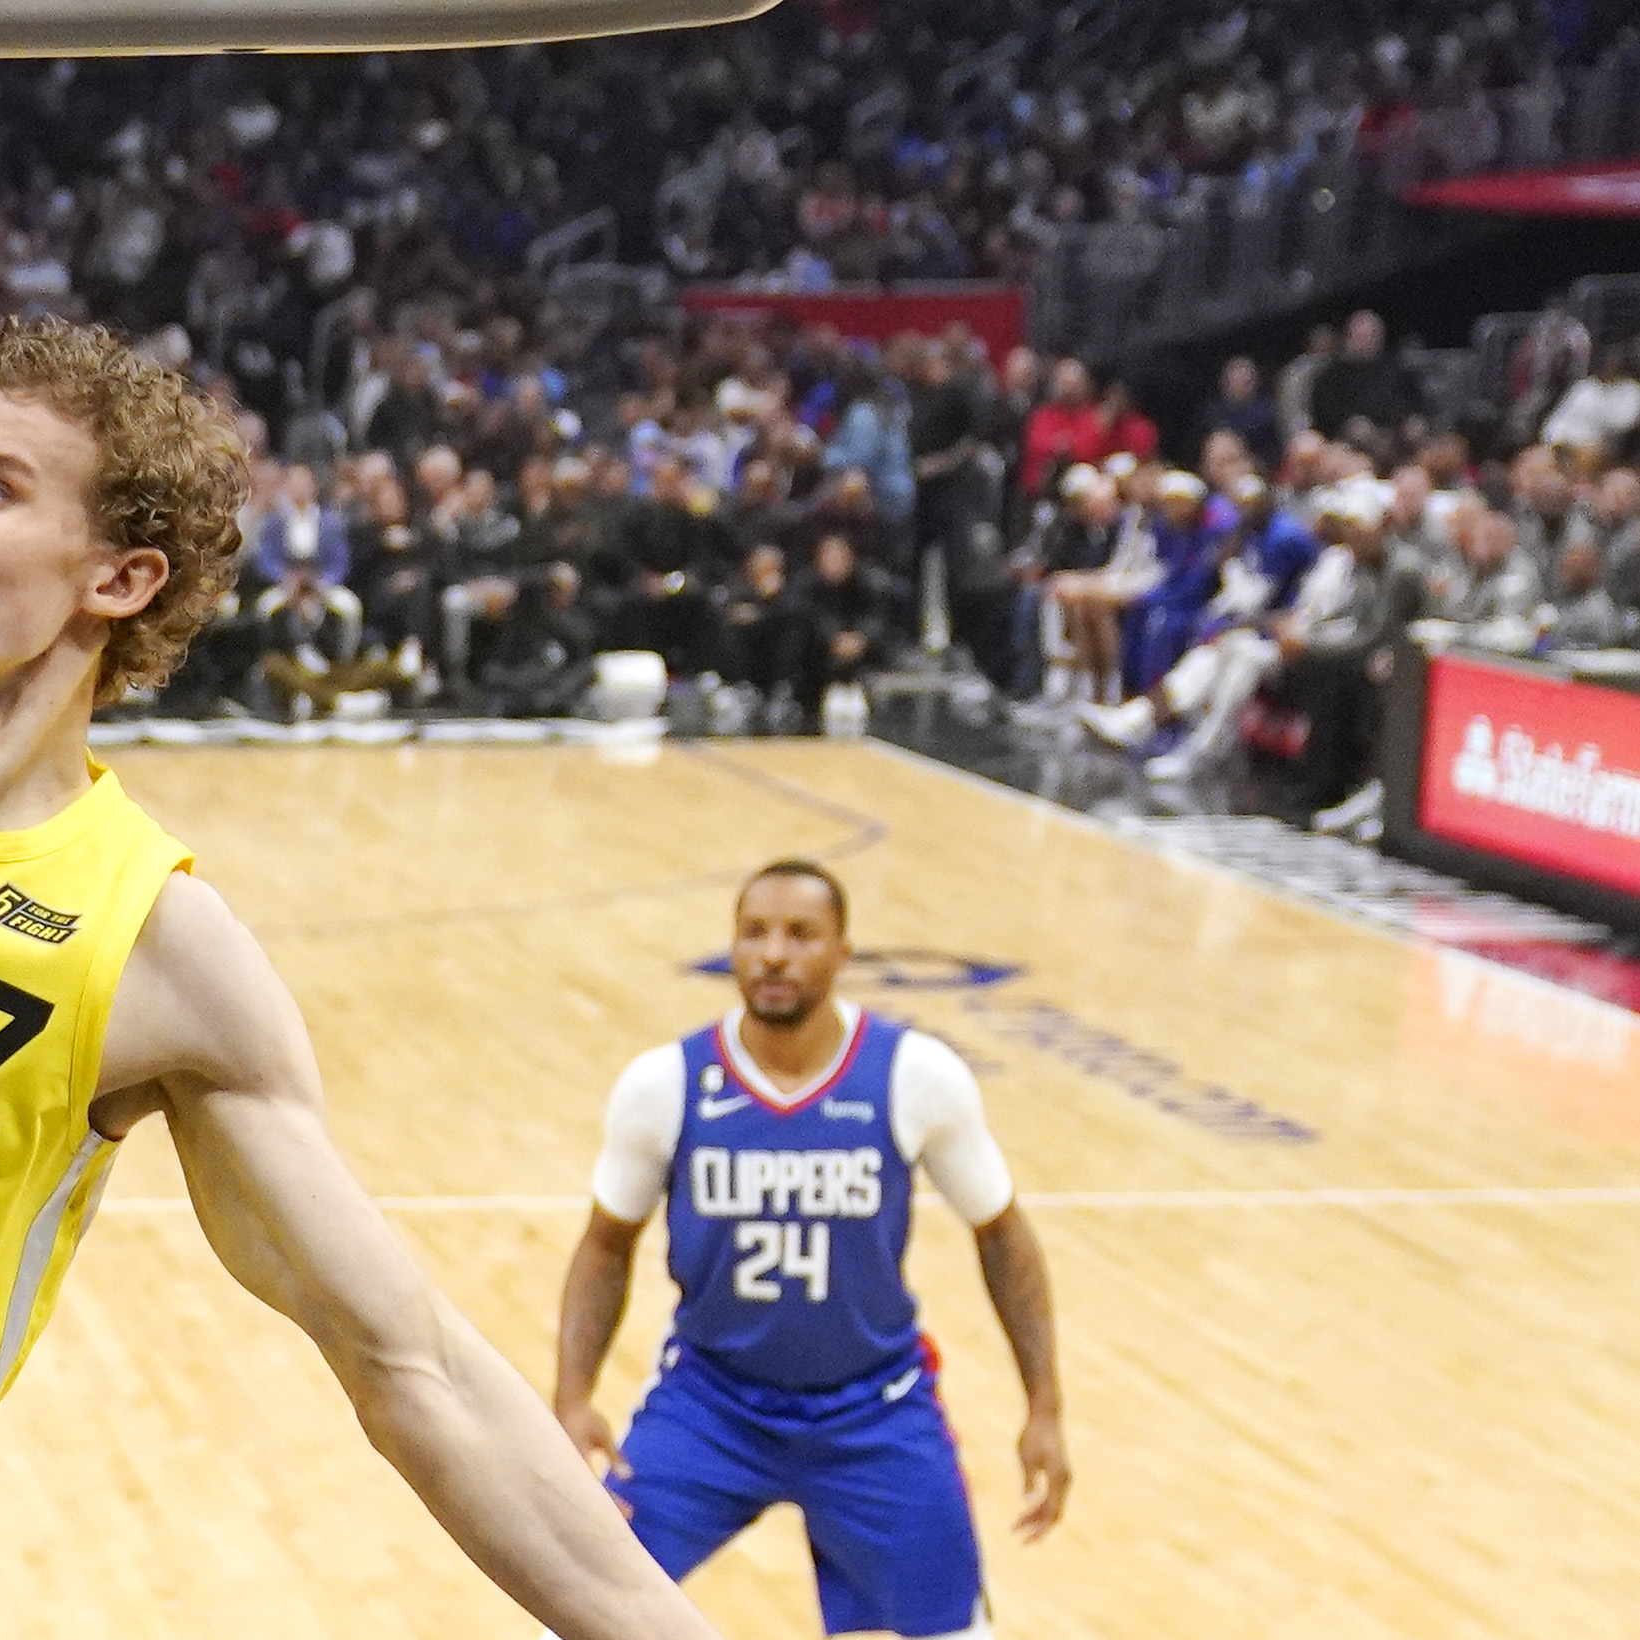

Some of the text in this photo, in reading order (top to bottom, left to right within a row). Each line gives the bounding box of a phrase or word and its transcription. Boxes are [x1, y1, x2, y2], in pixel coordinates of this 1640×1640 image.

[8, 914, 70, 942] FIGHT
[690, 1145, 883, 1219] CLIPPERS
[733, 1220, 831, 1302] 24
